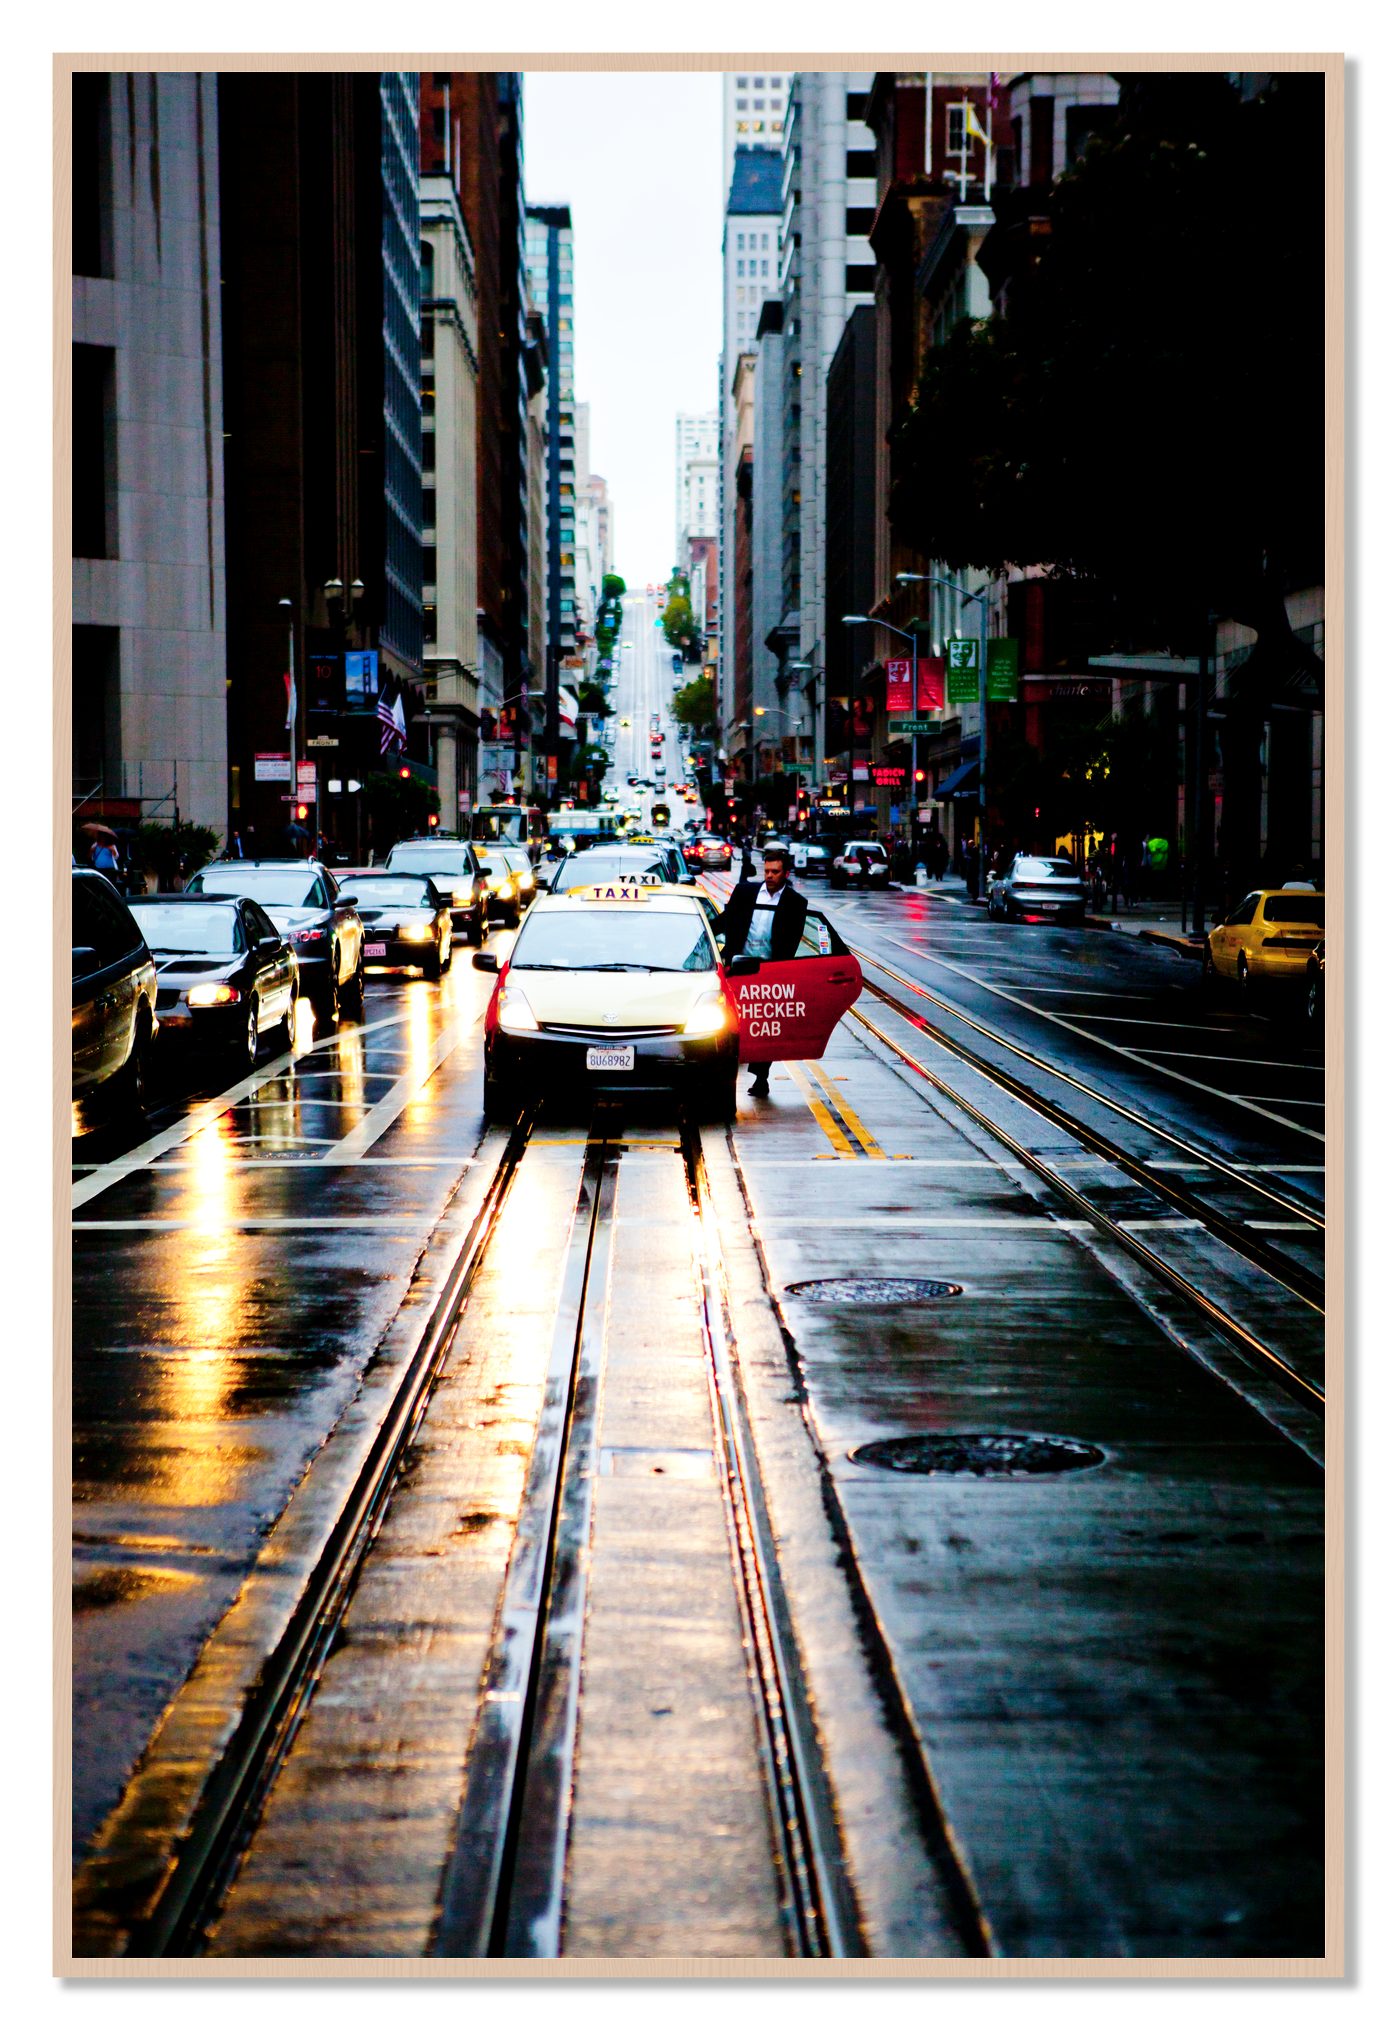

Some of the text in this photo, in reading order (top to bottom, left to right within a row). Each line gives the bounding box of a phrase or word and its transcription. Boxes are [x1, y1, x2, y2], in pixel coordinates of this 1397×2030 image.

[902, 723, 928, 731] Front
[872, 768, 906, 777] TADICH
[876, 777, 901, 786] GRILL
[619, 876, 656, 884] TAXI
[593, 888, 639, 899] TAXI
[739, 983, 796, 1000] ARROW
[749, 1021, 782, 1037] CAB
[590, 1054, 631, 1067] 8U68982
